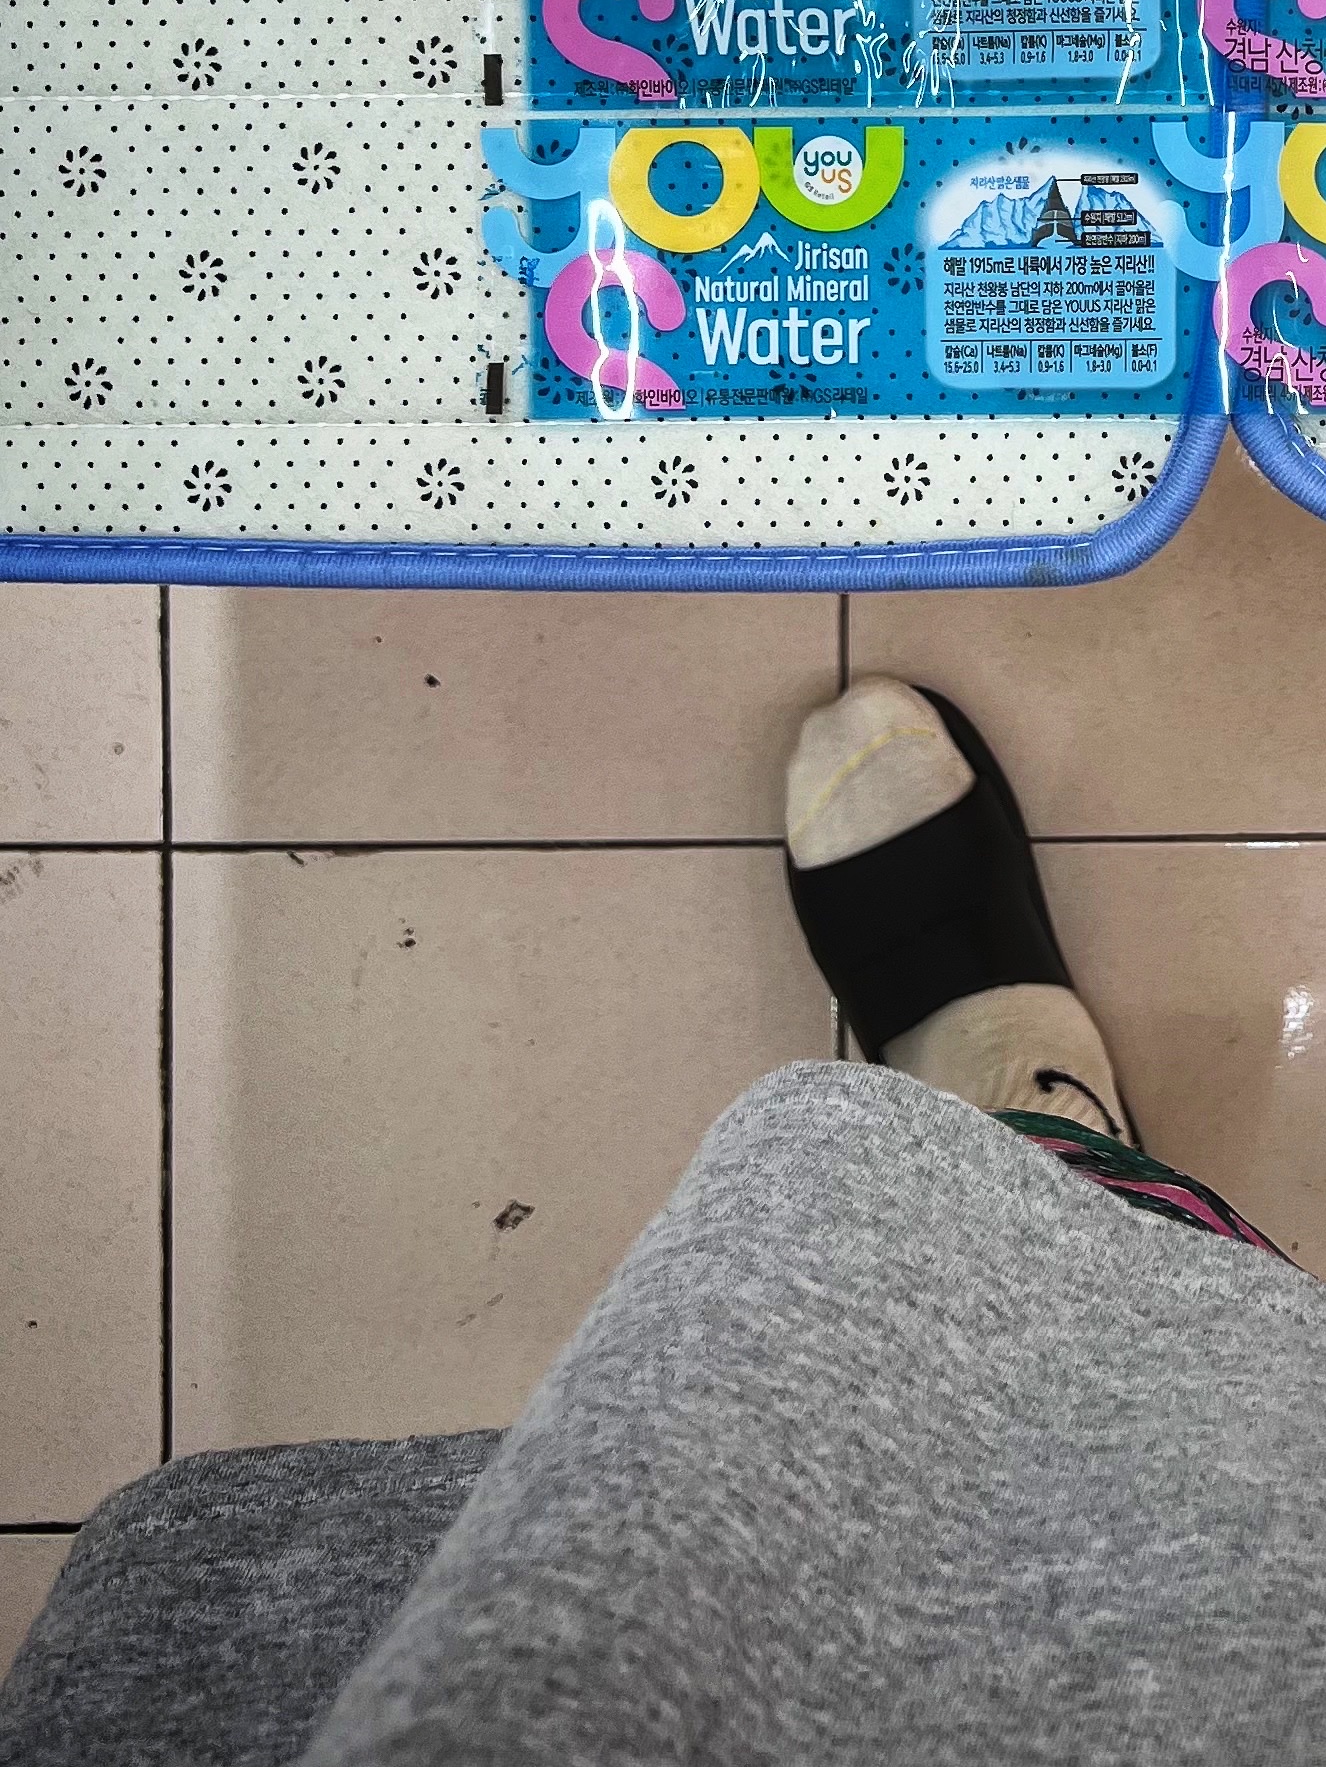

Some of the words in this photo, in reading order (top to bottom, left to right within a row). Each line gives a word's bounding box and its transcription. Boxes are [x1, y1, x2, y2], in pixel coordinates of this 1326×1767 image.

[965, 9, 1003, 24] 지리산의
[1006, 8, 1047, 24] 청정함과
[1051, 7, 1091, 23] 신선함을
[1224, 38, 1271, 74] 경남
[804, 151, 852, 177] you
[821, 168, 852, 194] us
[795, 240, 868, 272] Jirisan
[944, 257, 966, 275] 해발
[969, 257, 1015, 275] 1915m로
[1018, 257, 1062, 275] 내륙에서
[1065, 256, 1087, 275] 가장
[1090, 256, 1112, 275] 높은
[1115, 255, 1155, 274] 지리산!!
[694, 274, 779, 304] Natural
[787, 274, 870, 303] Mineral
[944, 282, 975, 297] 지리산
[978, 282, 1008, 297] 천왕봉
[1010, 281, 1040, 297] 남단의
[1043, 281, 1064, 296] 지하
[1066, 281, 1113, 296] 200m에서
[1115, 280, 1155, 296] 끌어올린
[944, 300, 1006, 315] 천연암반수를
[1009, 300, 1039, 314] 그대로
[1042, 299, 1063, 314] 담은
[1066, 300, 1101, 313] YOUUS
[1103, 299, 1133, 314] 지리산
[1136, 298, 1156, 314] 맑은
[695, 306, 871, 366] Water
[944, 319, 976, 334] 샘물로
[979, 318, 1021, 333] 지리산의
[1024, 318, 1066, 333] 청정함과
[1069, 317, 1110, 333] 신선함을
[1240, 345, 1287, 383] 경남
